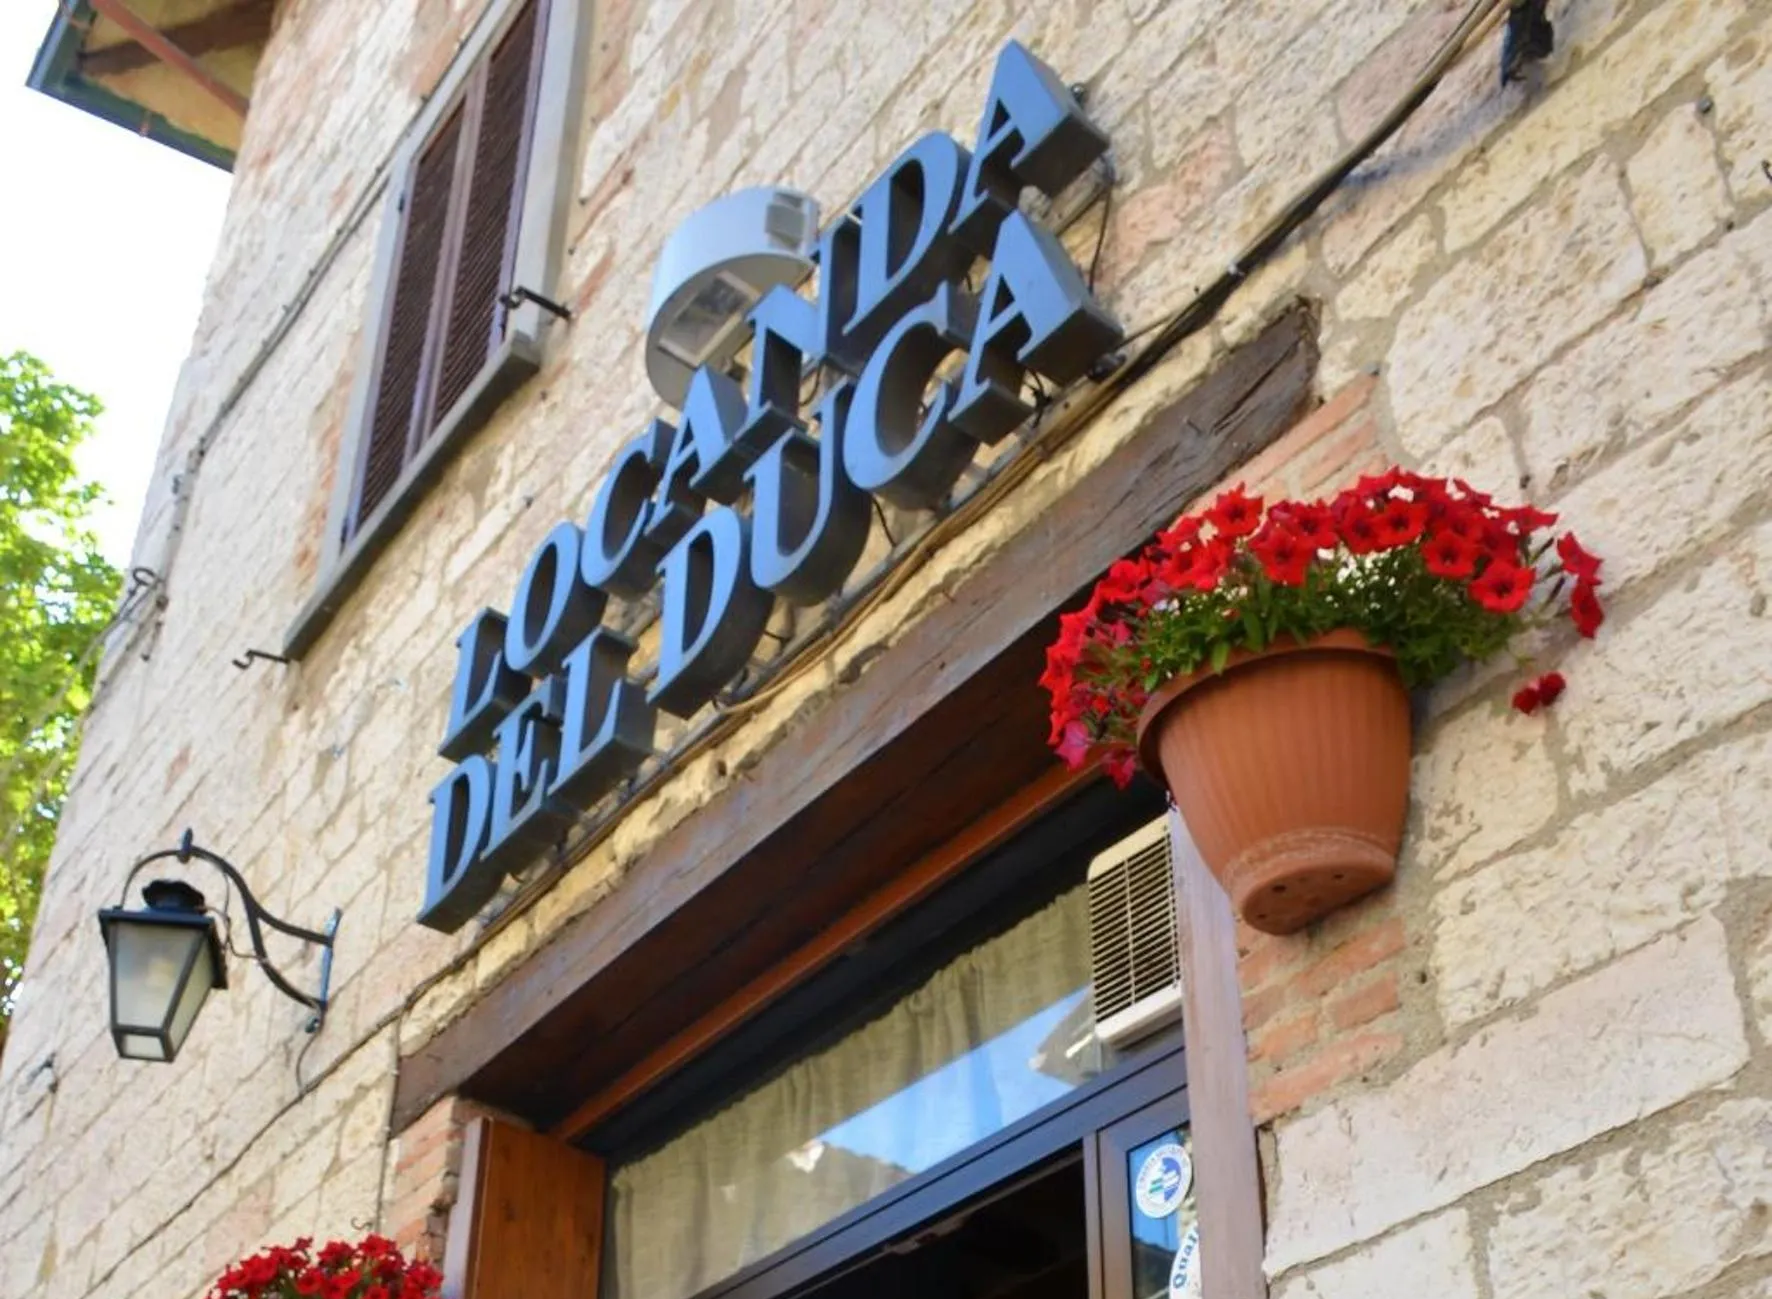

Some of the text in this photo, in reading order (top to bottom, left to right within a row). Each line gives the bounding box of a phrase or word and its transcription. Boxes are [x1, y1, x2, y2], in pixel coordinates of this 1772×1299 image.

[417, 207, 1108, 928] DEL DUCA
[438, 38, 1095, 762] LOCANDA
